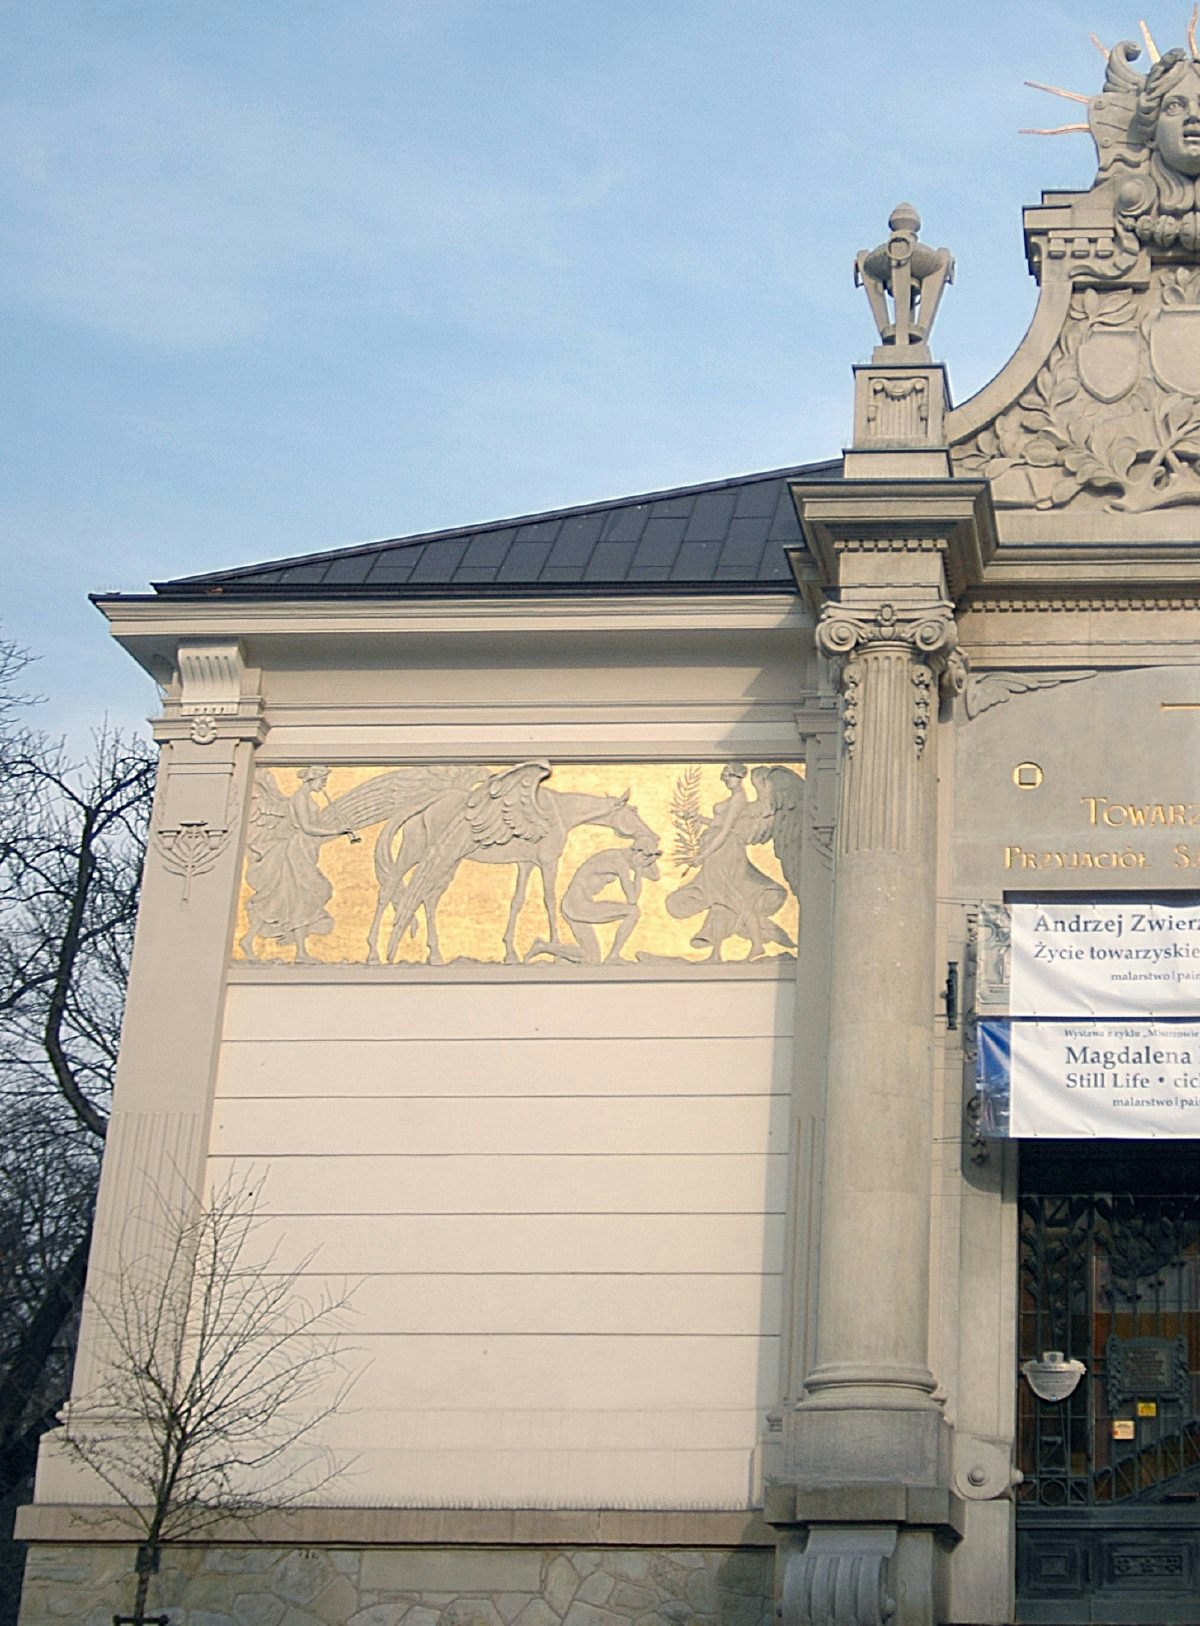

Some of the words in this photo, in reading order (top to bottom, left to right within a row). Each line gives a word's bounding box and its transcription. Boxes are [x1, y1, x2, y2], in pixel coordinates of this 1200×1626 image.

[1033, 914, 1123, 938] Andrzej
[1034, 941, 1085, 963] Życie
[1090, 943, 1200, 964] towarzyskie
[1065, 1045, 1192, 1070] Magdalena
[1066, 1072, 1105, 1088] Still
[1112, 1072, 1151, 1088] Life
